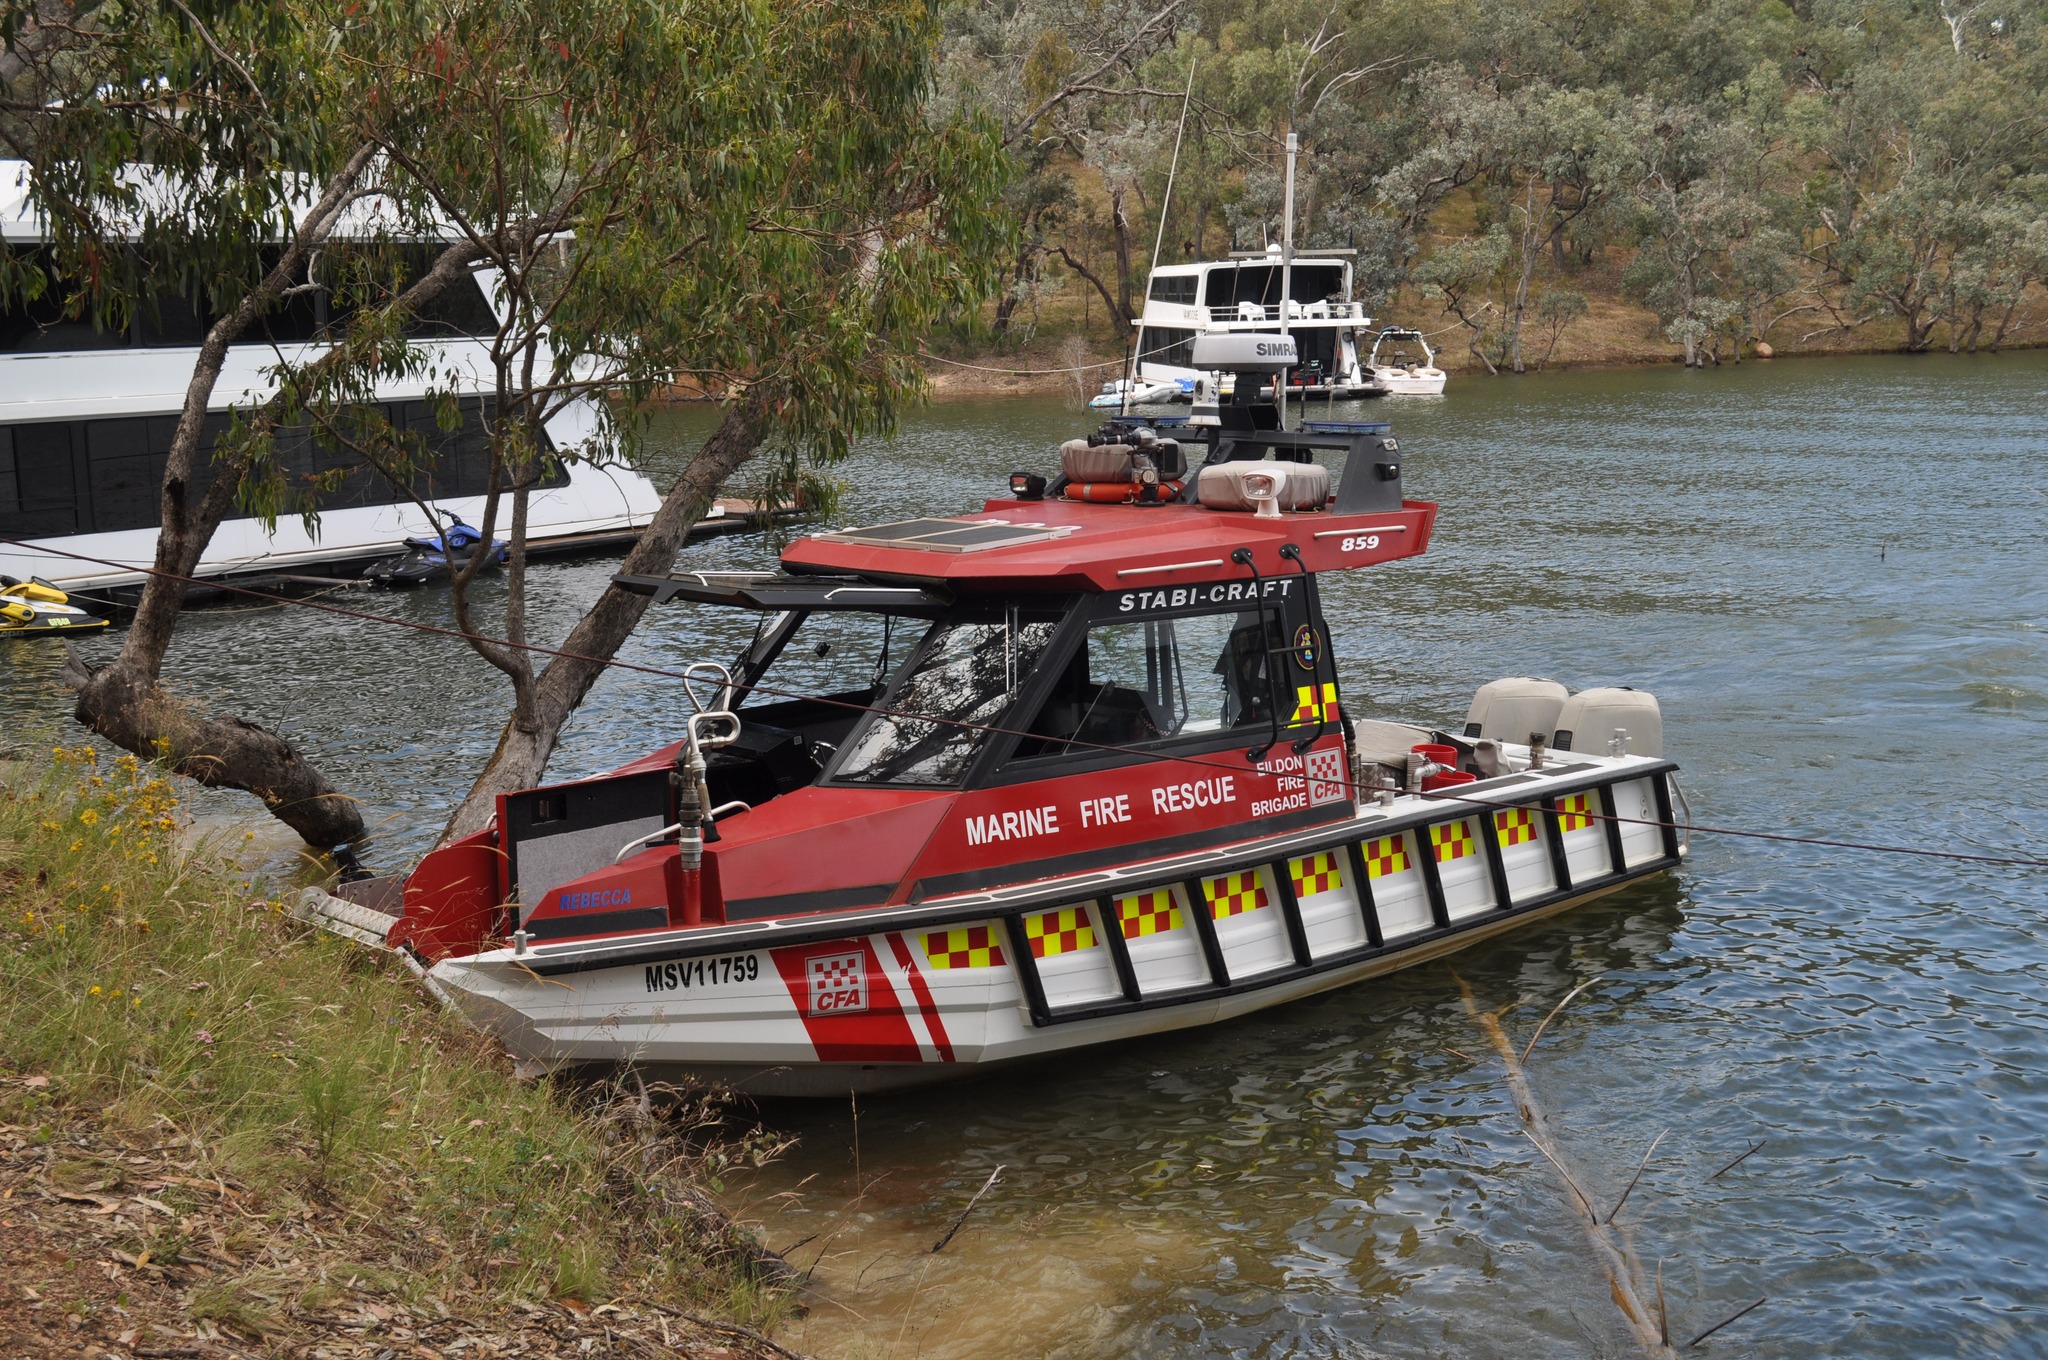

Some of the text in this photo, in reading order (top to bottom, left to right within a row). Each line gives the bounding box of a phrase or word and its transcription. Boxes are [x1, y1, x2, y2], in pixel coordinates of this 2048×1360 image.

[1340, 535, 1380, 551] 859
[1118, 579, 1293, 612] STABI-CRAFT
[1256, 755, 1303, 777] EILDON
[1277, 773, 1306, 792] FIRE
[1314, 781, 1340, 800] CFA
[965, 776, 1236, 846] MARINE FIRE RESCUE
[1251, 792, 1308, 817] BRIGADE
[559, 888, 632, 911] REBECCA
[645, 953, 759, 993] MSV11759
[816, 989, 861, 1011] CFA
